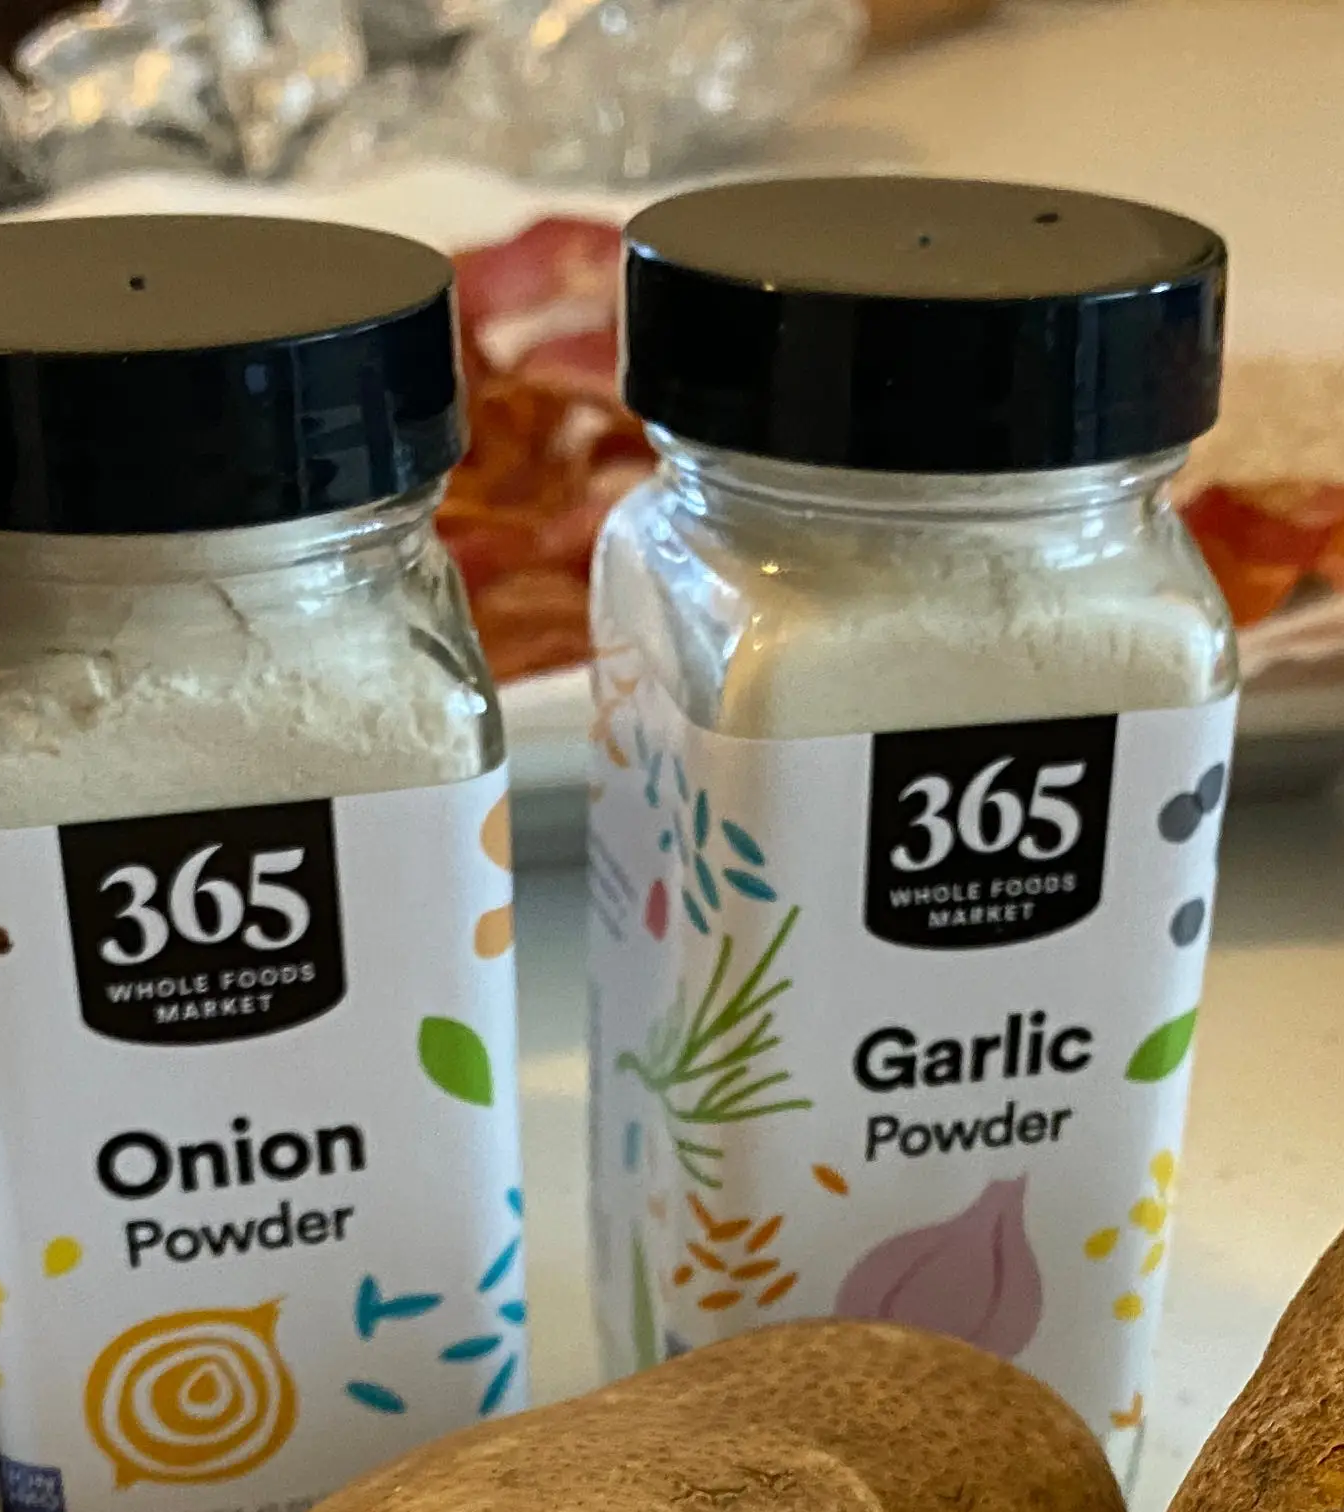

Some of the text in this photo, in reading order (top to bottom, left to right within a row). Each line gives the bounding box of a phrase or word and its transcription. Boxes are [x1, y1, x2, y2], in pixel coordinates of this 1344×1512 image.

[889, 755, 1087, 873] 365
[98, 842, 311, 966] 365
[889, 871, 1077, 909] WHOLE FOODS
[927, 901, 1035, 930] MARKET
[106, 961, 317, 1004] WHOLE FOODS
[155, 994, 274, 1024] MARKET
[853, 1009, 1094, 1094] Garlic
[96, 1116, 366, 1199] Onion
[865, 1101, 1074, 1162] Powder
[124, 1201, 356, 1269] Powder
